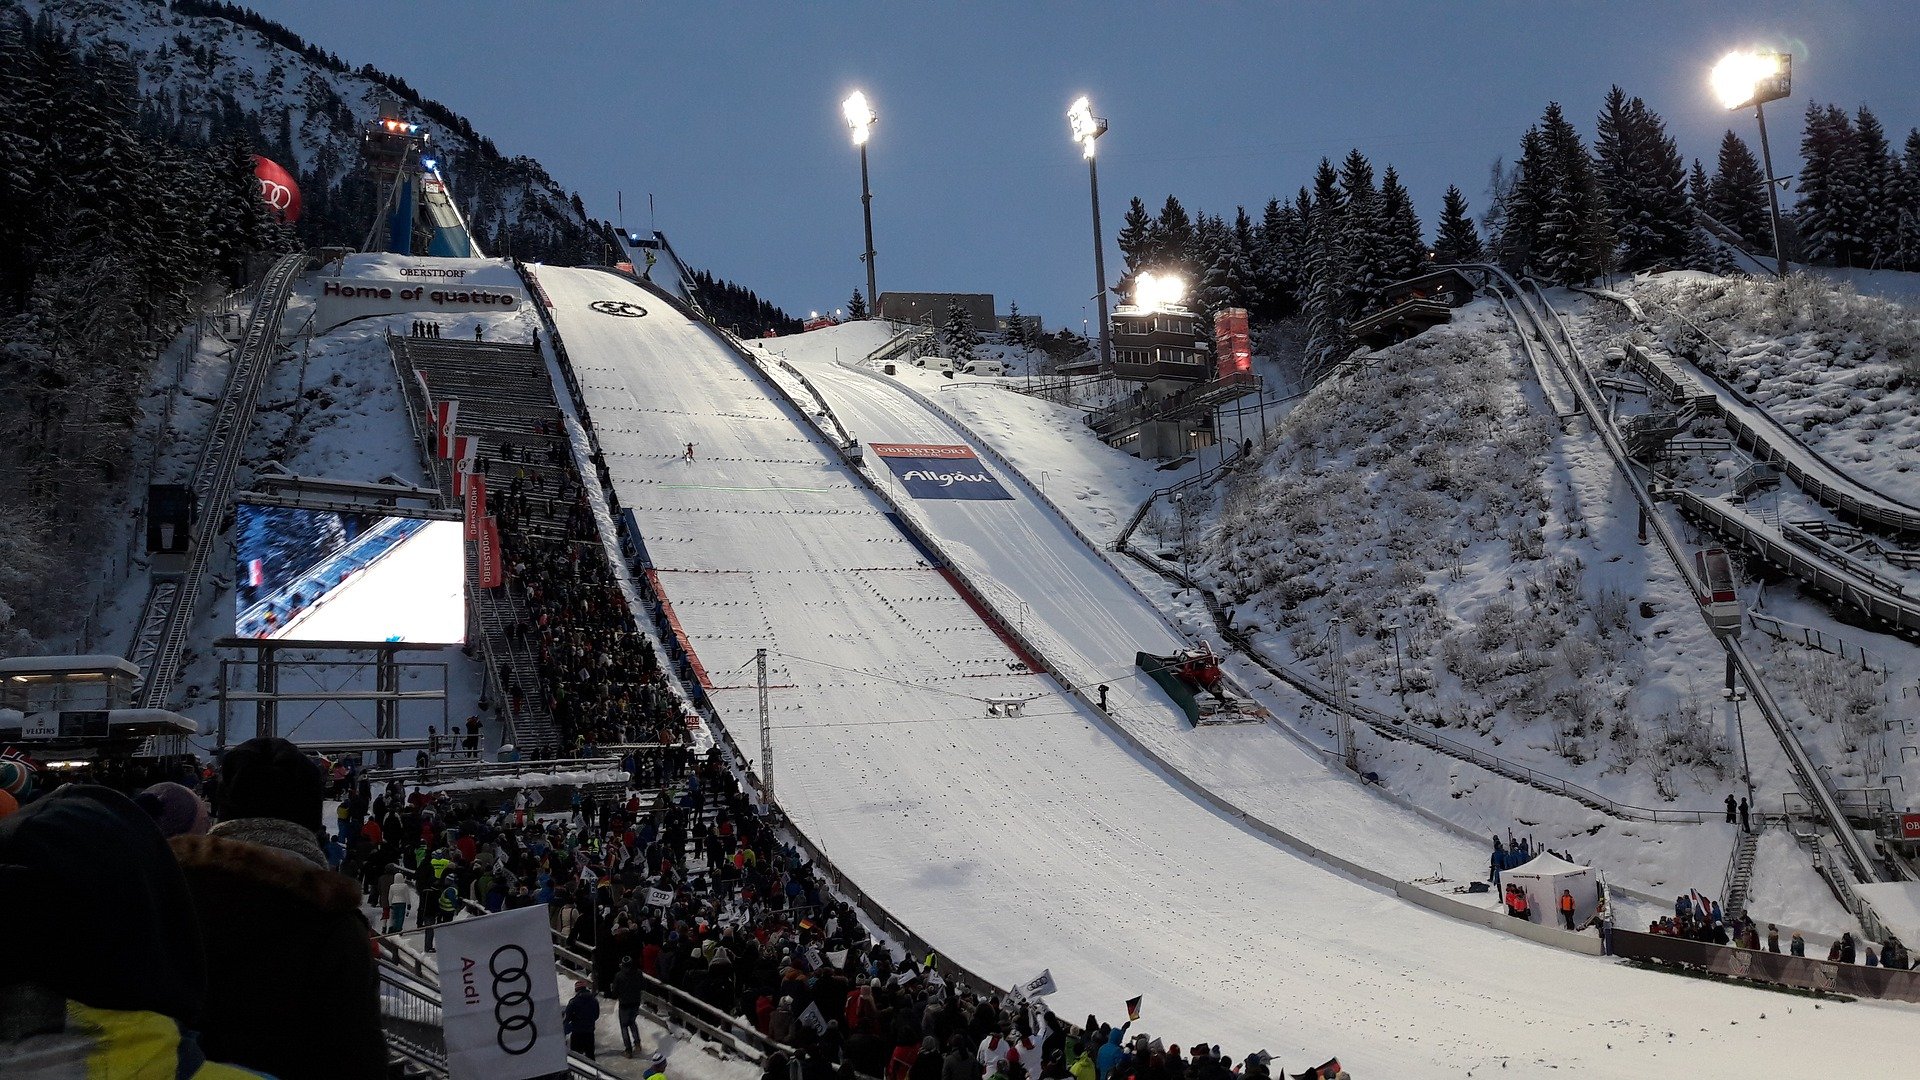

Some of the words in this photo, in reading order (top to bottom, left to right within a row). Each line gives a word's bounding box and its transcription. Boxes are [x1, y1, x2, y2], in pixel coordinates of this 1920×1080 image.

[399, 268, 467, 278] OBERSTDORF
[324, 280, 392, 300] Home
[399, 286, 425, 301] of
[430, 289, 514, 306] quattro
[877, 446, 969, 456] OBERSTDORF
[902, 470, 992, 488] Allgäu
[483, 531, 492, 583] OBERSTDORF
[460, 956, 480, 1006] Audi
